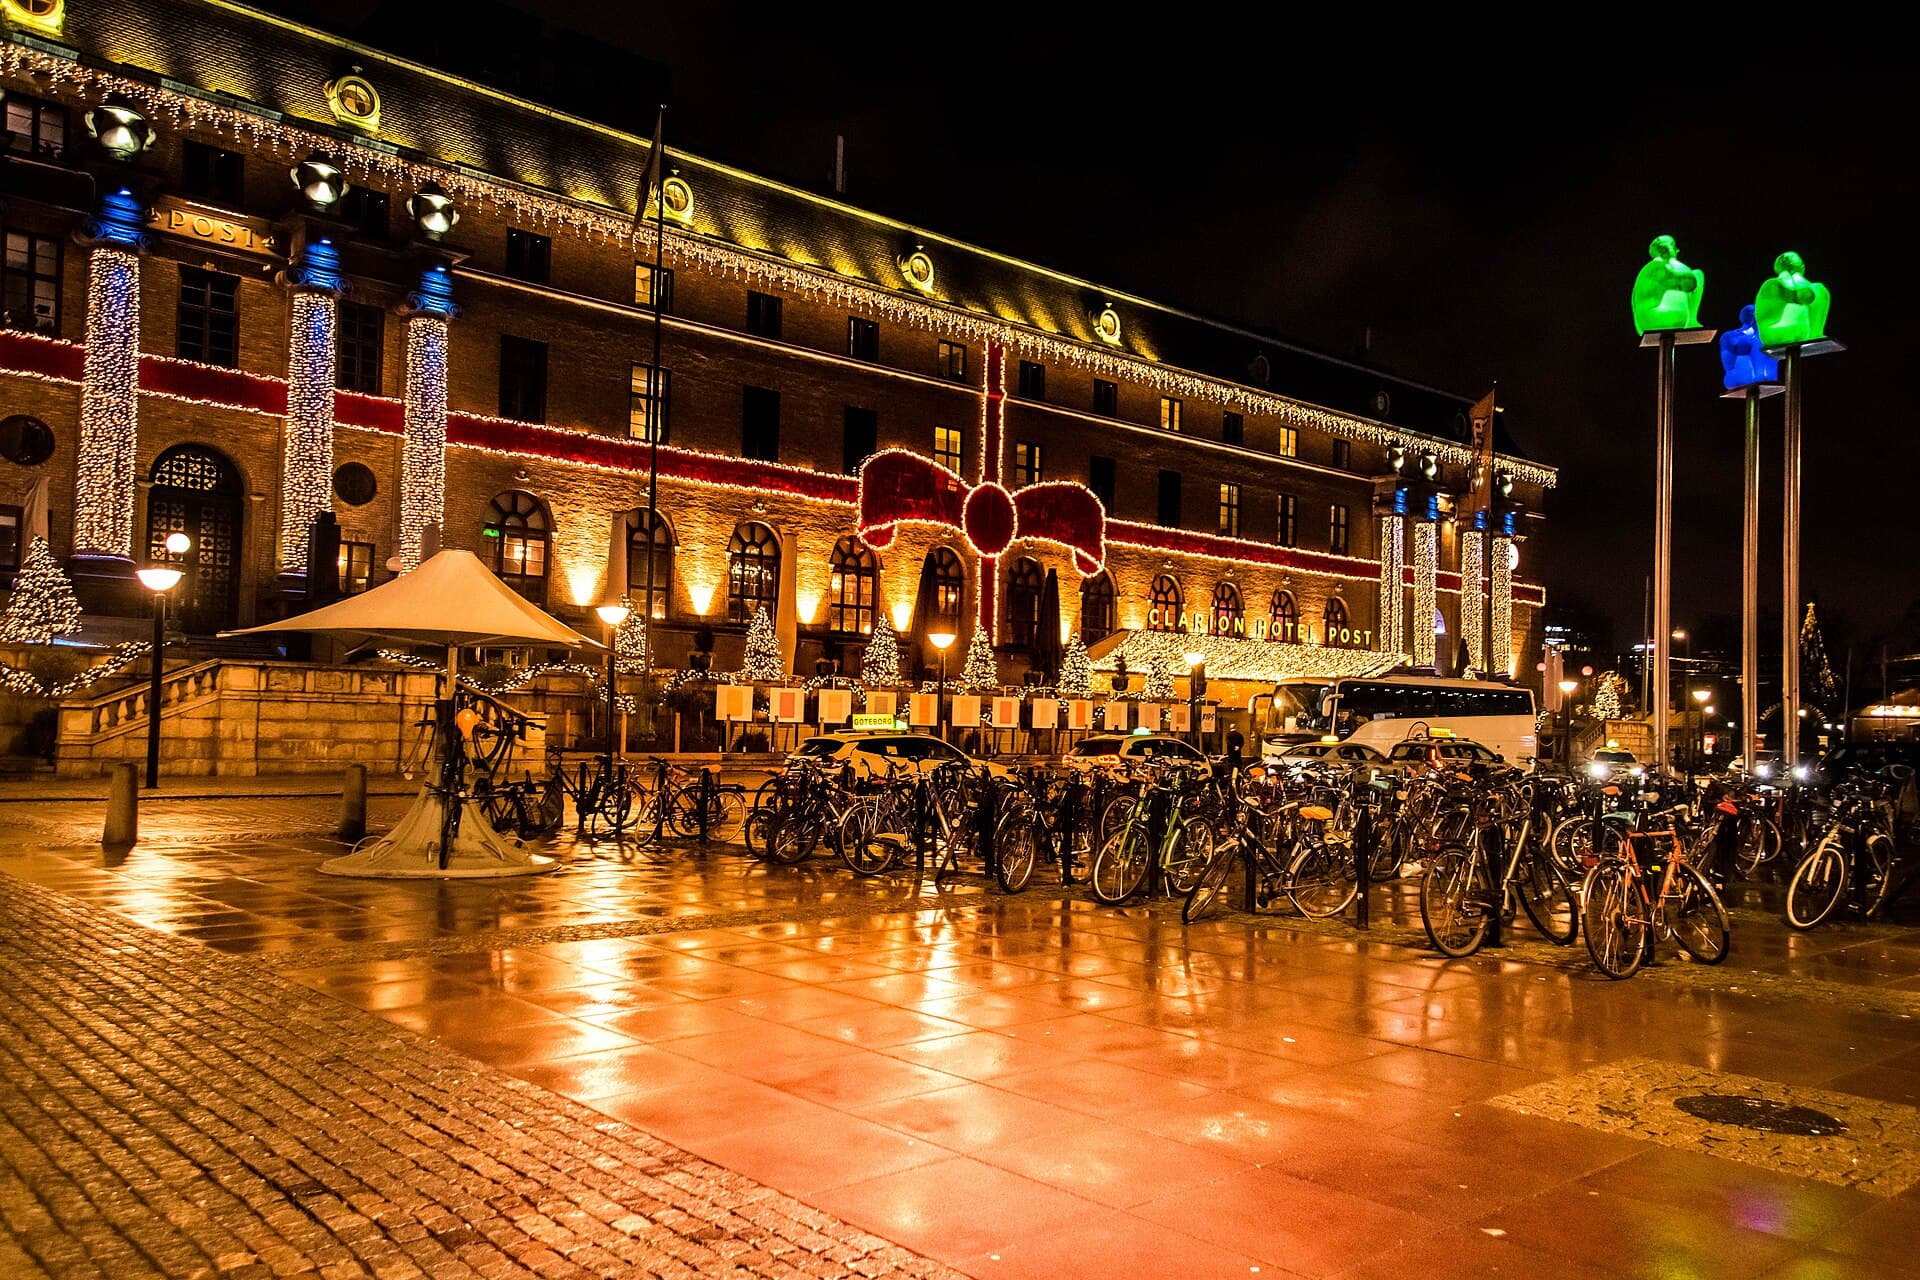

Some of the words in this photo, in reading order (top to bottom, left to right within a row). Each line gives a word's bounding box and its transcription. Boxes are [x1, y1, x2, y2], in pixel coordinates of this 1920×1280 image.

[168, 209, 254, 248] POST
[1149, 608, 1245, 634] CLARION
[1257, 618, 1314, 644] HOTEL
[1328, 627, 1372, 645] POST
